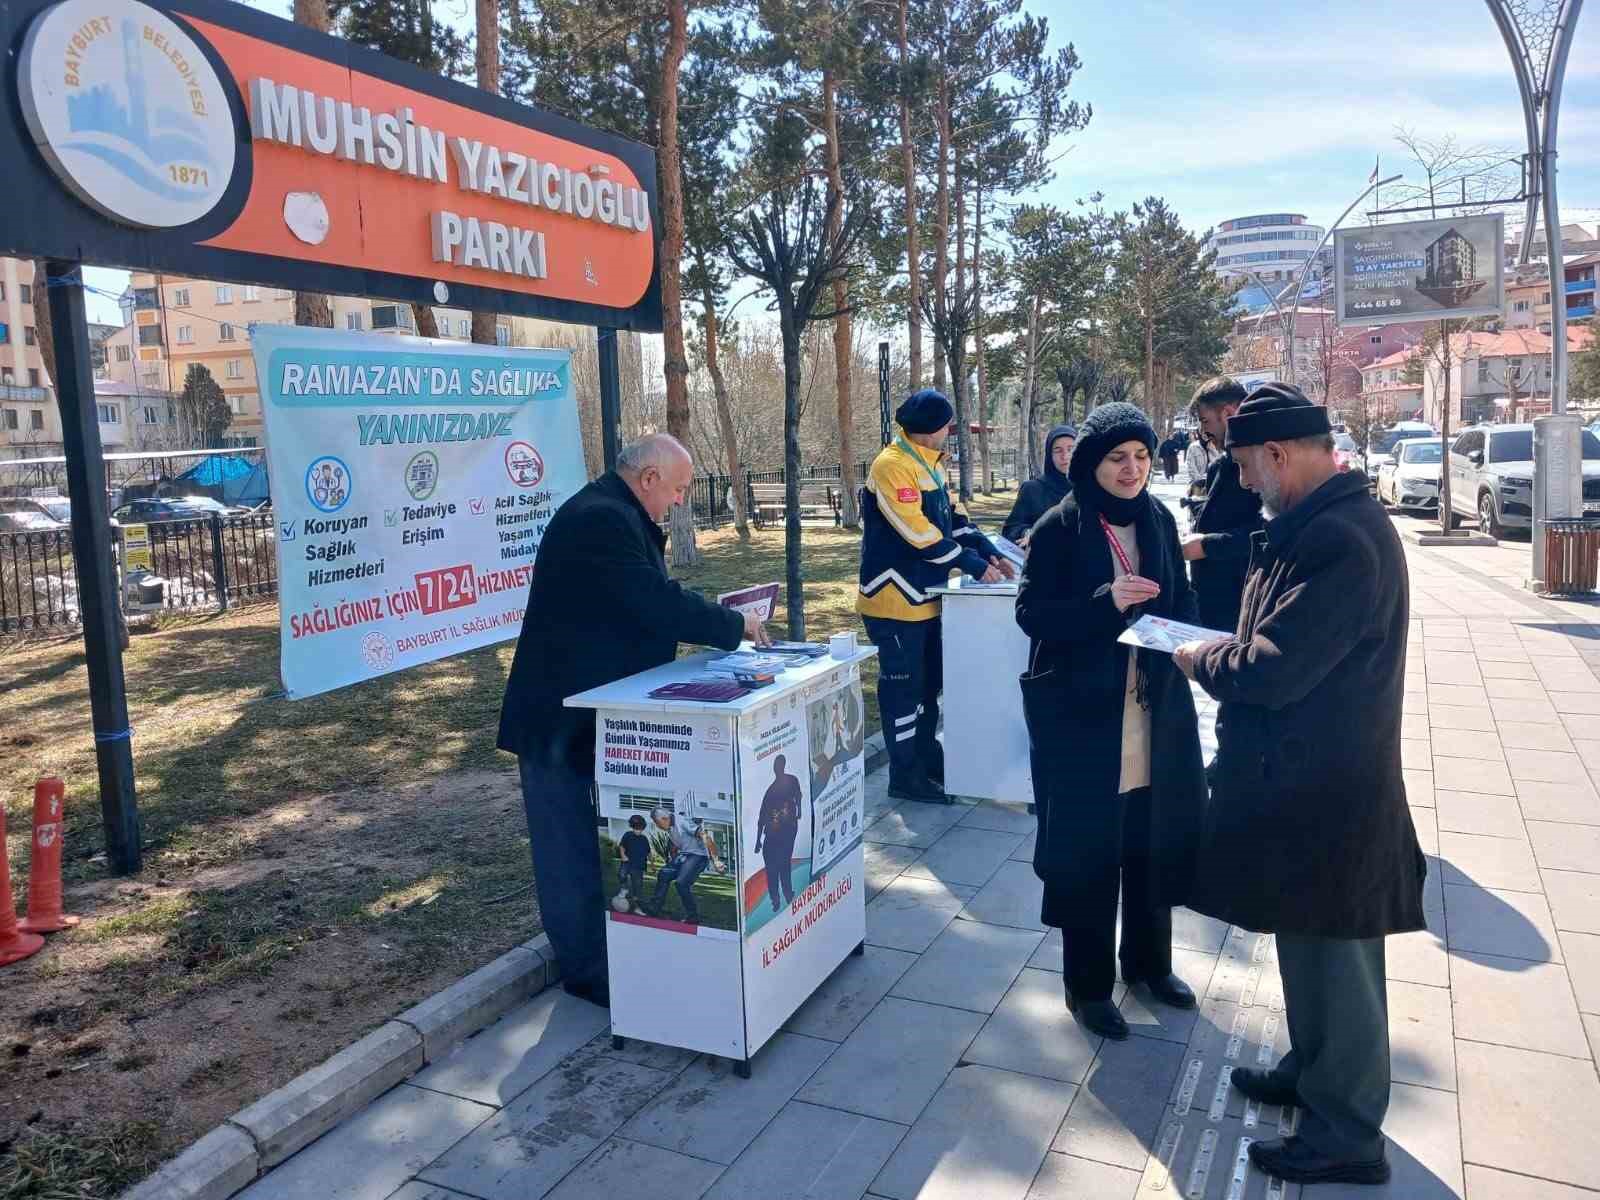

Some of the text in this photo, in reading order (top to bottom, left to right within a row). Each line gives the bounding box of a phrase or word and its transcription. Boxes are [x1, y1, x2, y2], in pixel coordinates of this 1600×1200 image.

[65, 16, 208, 117] BAYBURT BELEDİYESİ
[251, 77, 648, 232] MUHSİN YAZICIOĞLU
[169, 164, 209, 187] 1871
[434, 210, 547, 278] PARKI
[281, 363, 462, 395] RAMAZAN'DA
[495, 489, 552, 509] Acil Sağlık
[402, 502, 457, 521] Tedaviye
[496, 507, 550, 526] Hizmetleri
[304, 515, 368, 535] Koruyan
[499, 528, 534, 543] Yaşam
[402, 527, 444, 546] Erişim
[306, 540, 356, 561] Sağlık
[308, 559, 385, 587] Hizmetleri
[290, 597, 384, 639] SAĞLIĞINIZ
[385, 586, 419, 620] İÇİN
[420, 568, 474, 608] 7/24
[396, 628, 447, 652] BAYBURT
[450, 623, 461, 639] İL
[463, 616, 500, 635] SAĞLIK
[605, 718, 692, 736] Yaşlılık Döneminde
[605, 732, 636, 746] Günlük
[638, 734, 690, 751] Yaşamınıza
[605, 747, 670, 763] HAREKET KATIN
[605, 761, 668, 778] Sağlıklı Kalın!
[792, 874, 827, 915] BAYBURT
[762, 872, 853, 968] İL SAĞLIK MÜDÜRLÜĞÜ
